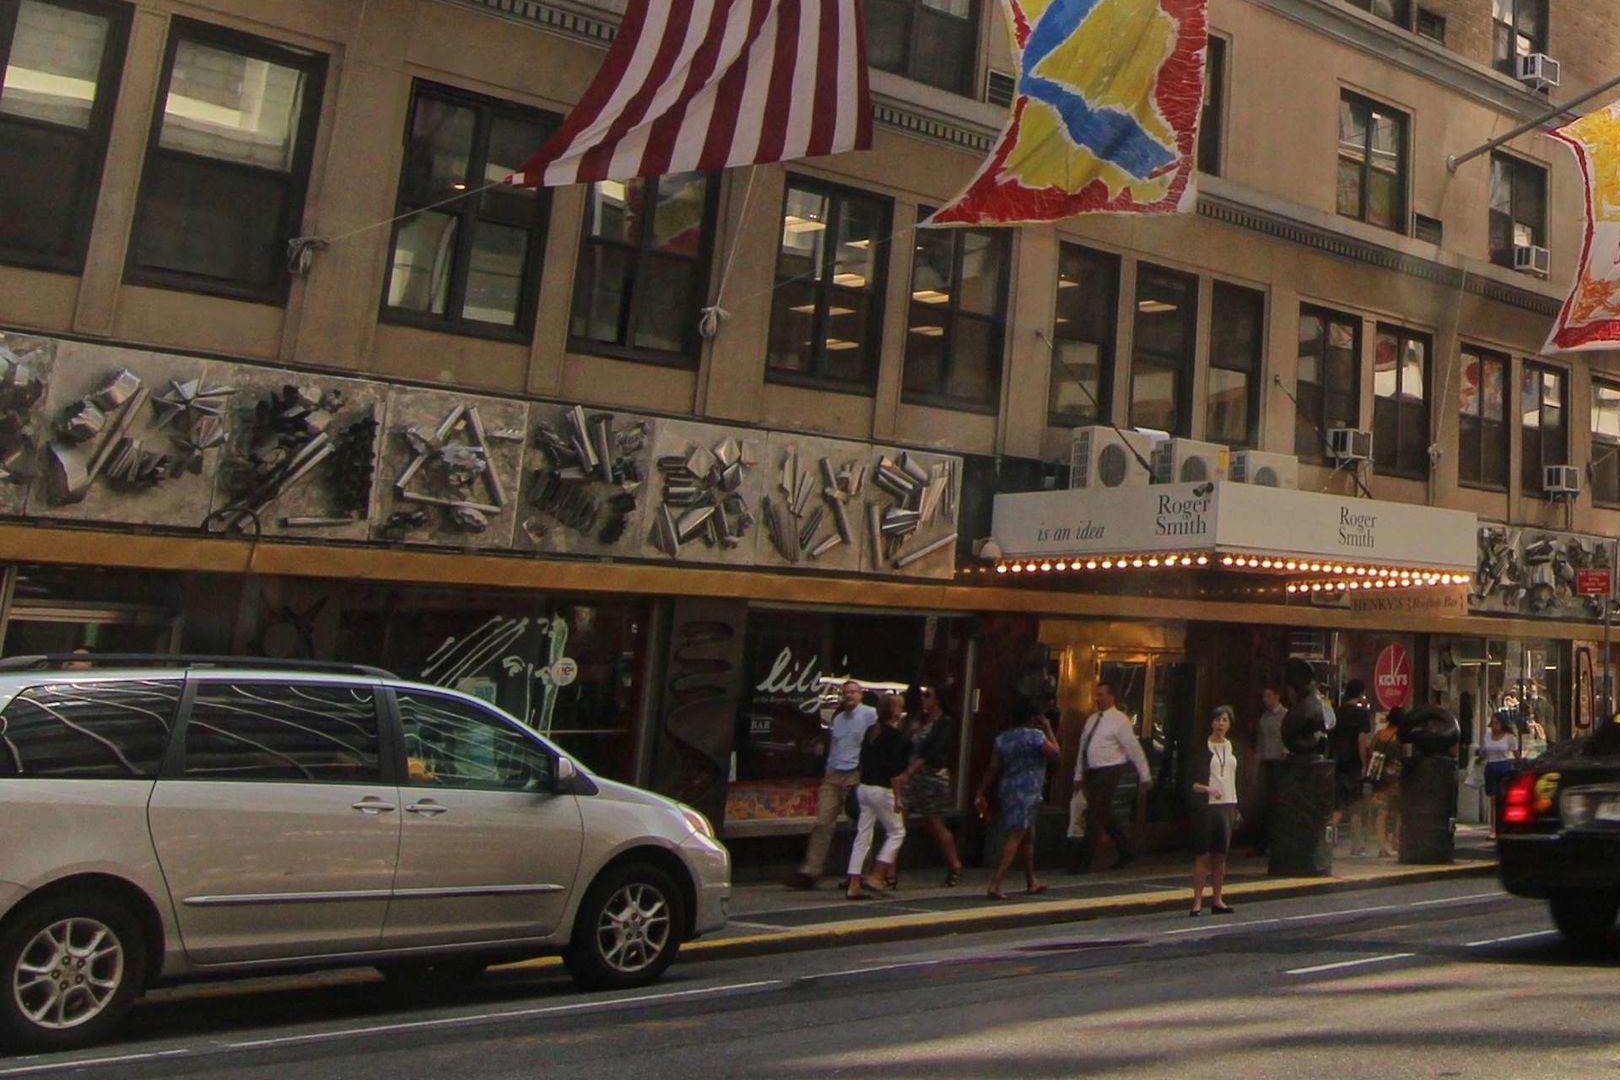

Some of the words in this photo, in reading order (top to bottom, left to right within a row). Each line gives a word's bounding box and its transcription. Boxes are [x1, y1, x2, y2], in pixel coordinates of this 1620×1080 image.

[1158, 494, 1211, 519] Roger
[1155, 514, 1207, 536] Smith
[1340, 506, 1377, 532] Roger
[1037, 522, 1050, 542] is
[1053, 527, 1071, 541] an
[1076, 521, 1105, 541] idea
[1338, 528, 1375, 548] Smith
[750, 720, 770, 730] BAR
